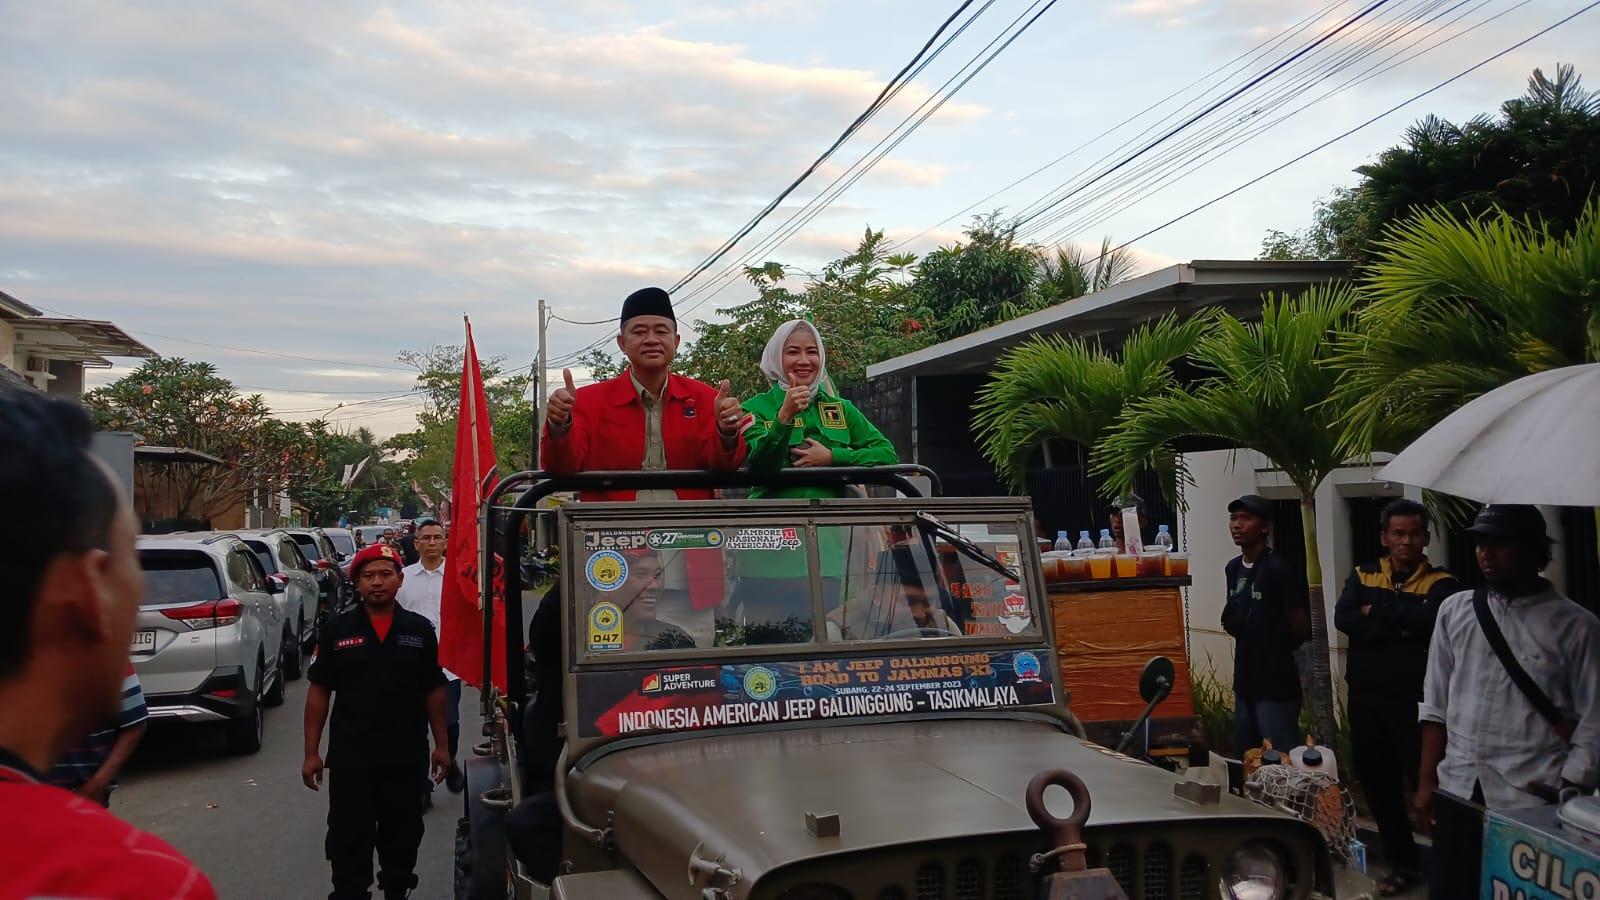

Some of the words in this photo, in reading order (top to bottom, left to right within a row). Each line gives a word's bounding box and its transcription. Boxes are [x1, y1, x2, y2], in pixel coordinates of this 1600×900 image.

[585, 531, 646, 549] Jeep
[661, 532, 678, 545] 27
[813, 662, 840, 673] AM
[846, 659, 884, 671] JEEP
[890, 653, 990, 669] GALUNGGUNG
[663, 673, 691, 683] SUPER
[802, 673, 850, 687] ROAD
[857, 671, 880, 683] TO
[887, 666, 964, 682] JAMNAS
[663, 679, 716, 691] ADVENTURE
[871, 685, 895, 693] 22-24
[896, 681, 941, 692] SEPTEMBER
[942, 680, 962, 689] 2023
[618, 706, 701, 734] INDONESIA
[702, 701, 779, 727] AMERICAN
[782, 698, 817, 721] JEEP
[819, 692, 914, 718] GALUNGGUNG
[926, 685, 1020, 711] TASIKMALAYA
